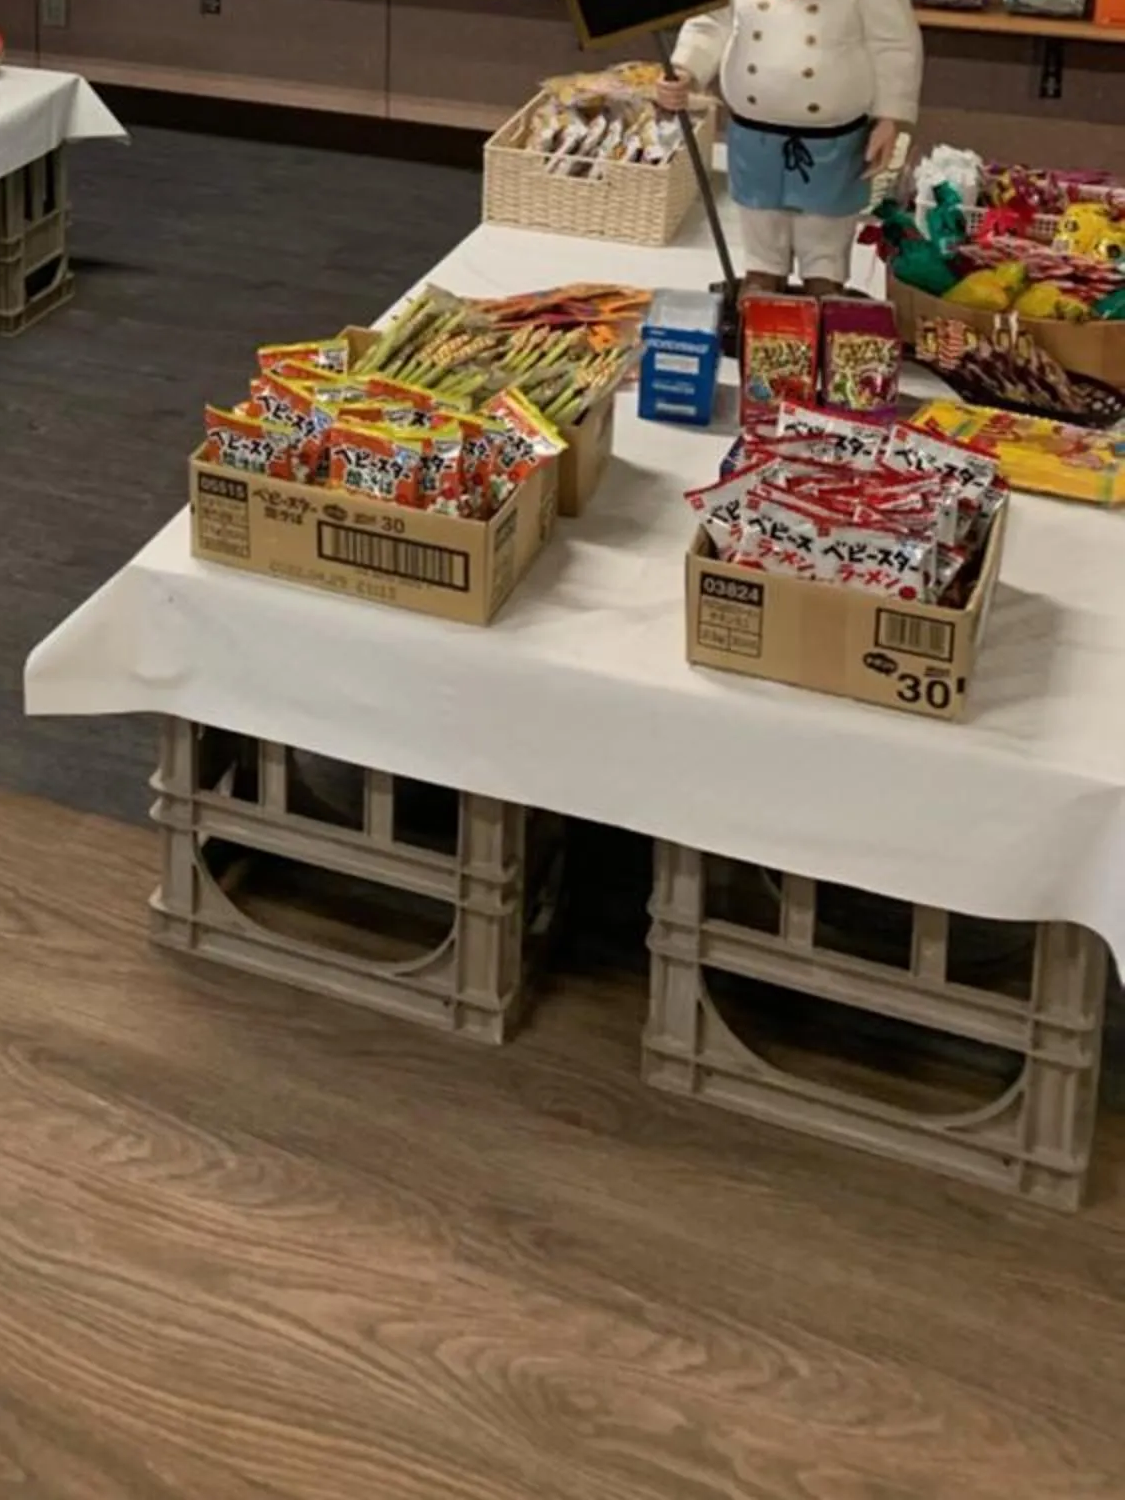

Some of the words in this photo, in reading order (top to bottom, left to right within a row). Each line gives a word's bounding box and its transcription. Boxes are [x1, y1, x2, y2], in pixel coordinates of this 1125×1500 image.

[381, 516, 405, 533] 30
[822, 541, 920, 573] ベビースター
[897, 673, 951, 709] 30
